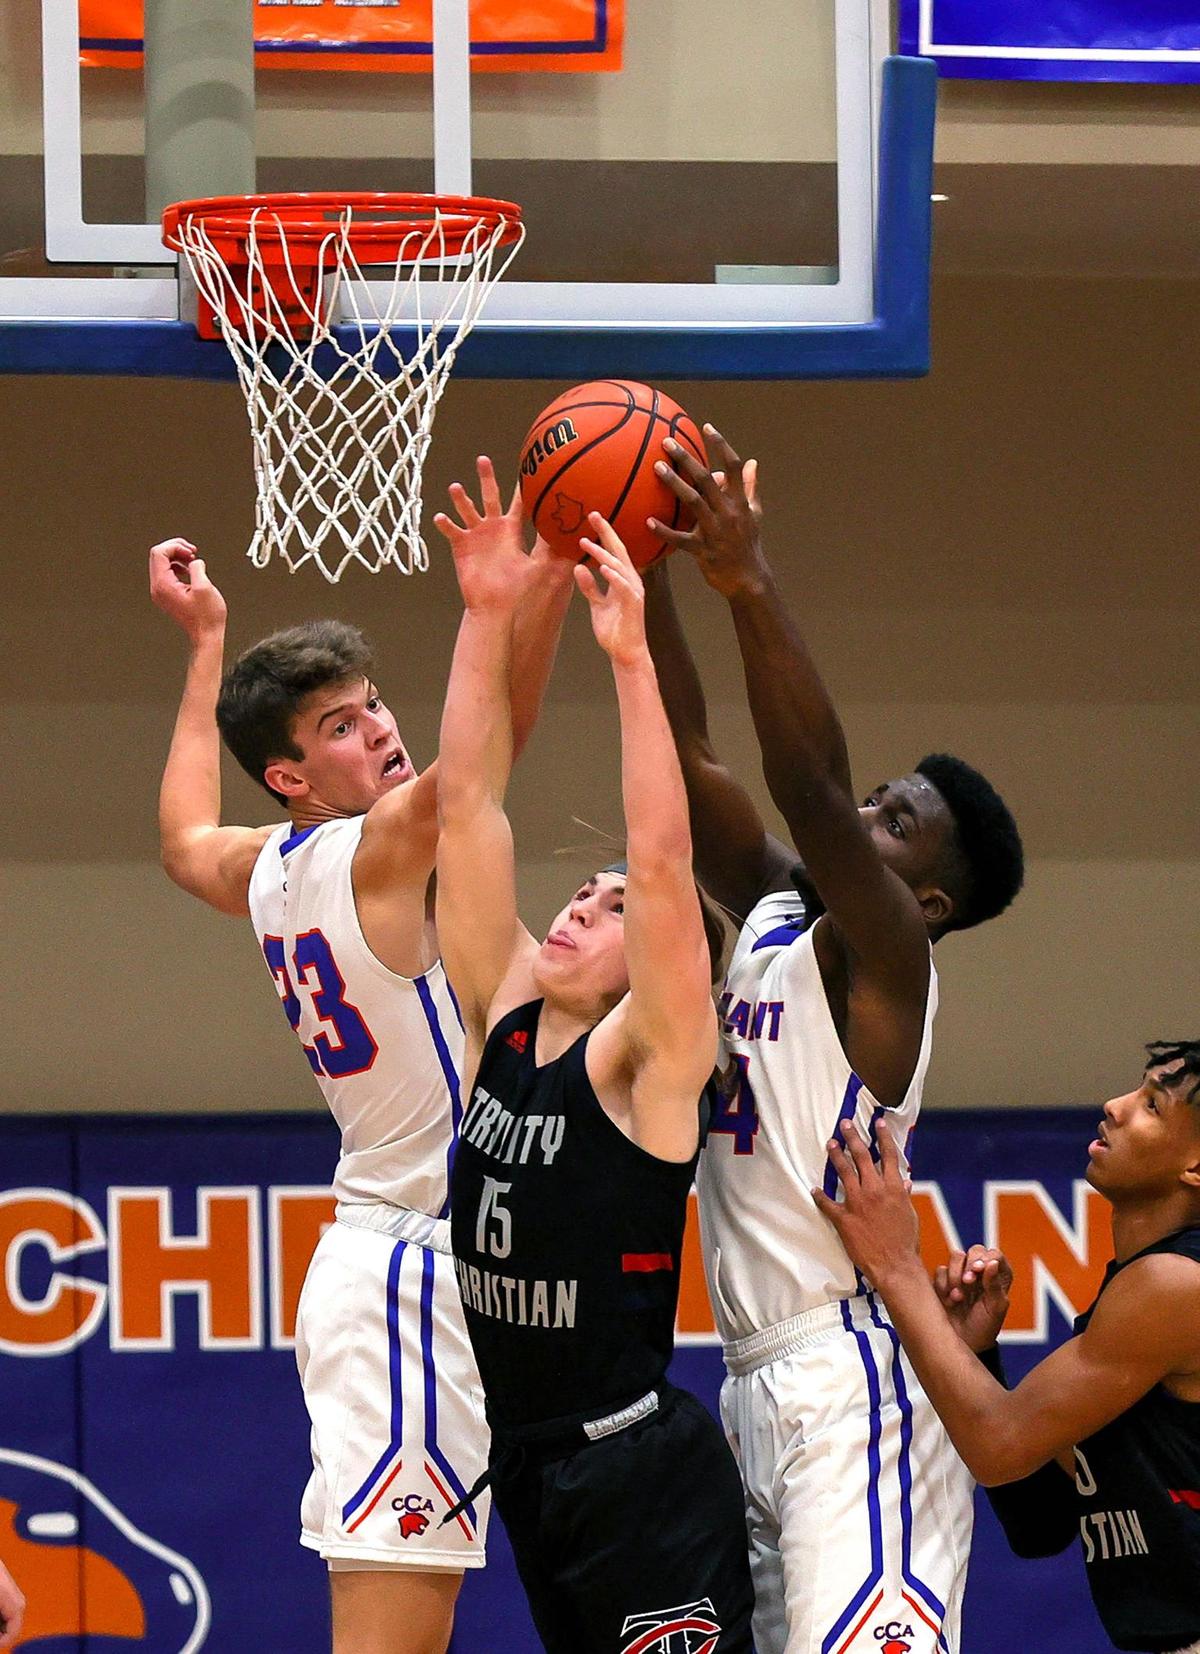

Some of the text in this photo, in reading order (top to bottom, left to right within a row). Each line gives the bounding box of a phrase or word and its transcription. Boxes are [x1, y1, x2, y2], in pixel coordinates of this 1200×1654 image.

[475, 1174, 513, 1259] 15
[391, 1493, 435, 1513] CCA
[873, 1621, 915, 1640] CCA
